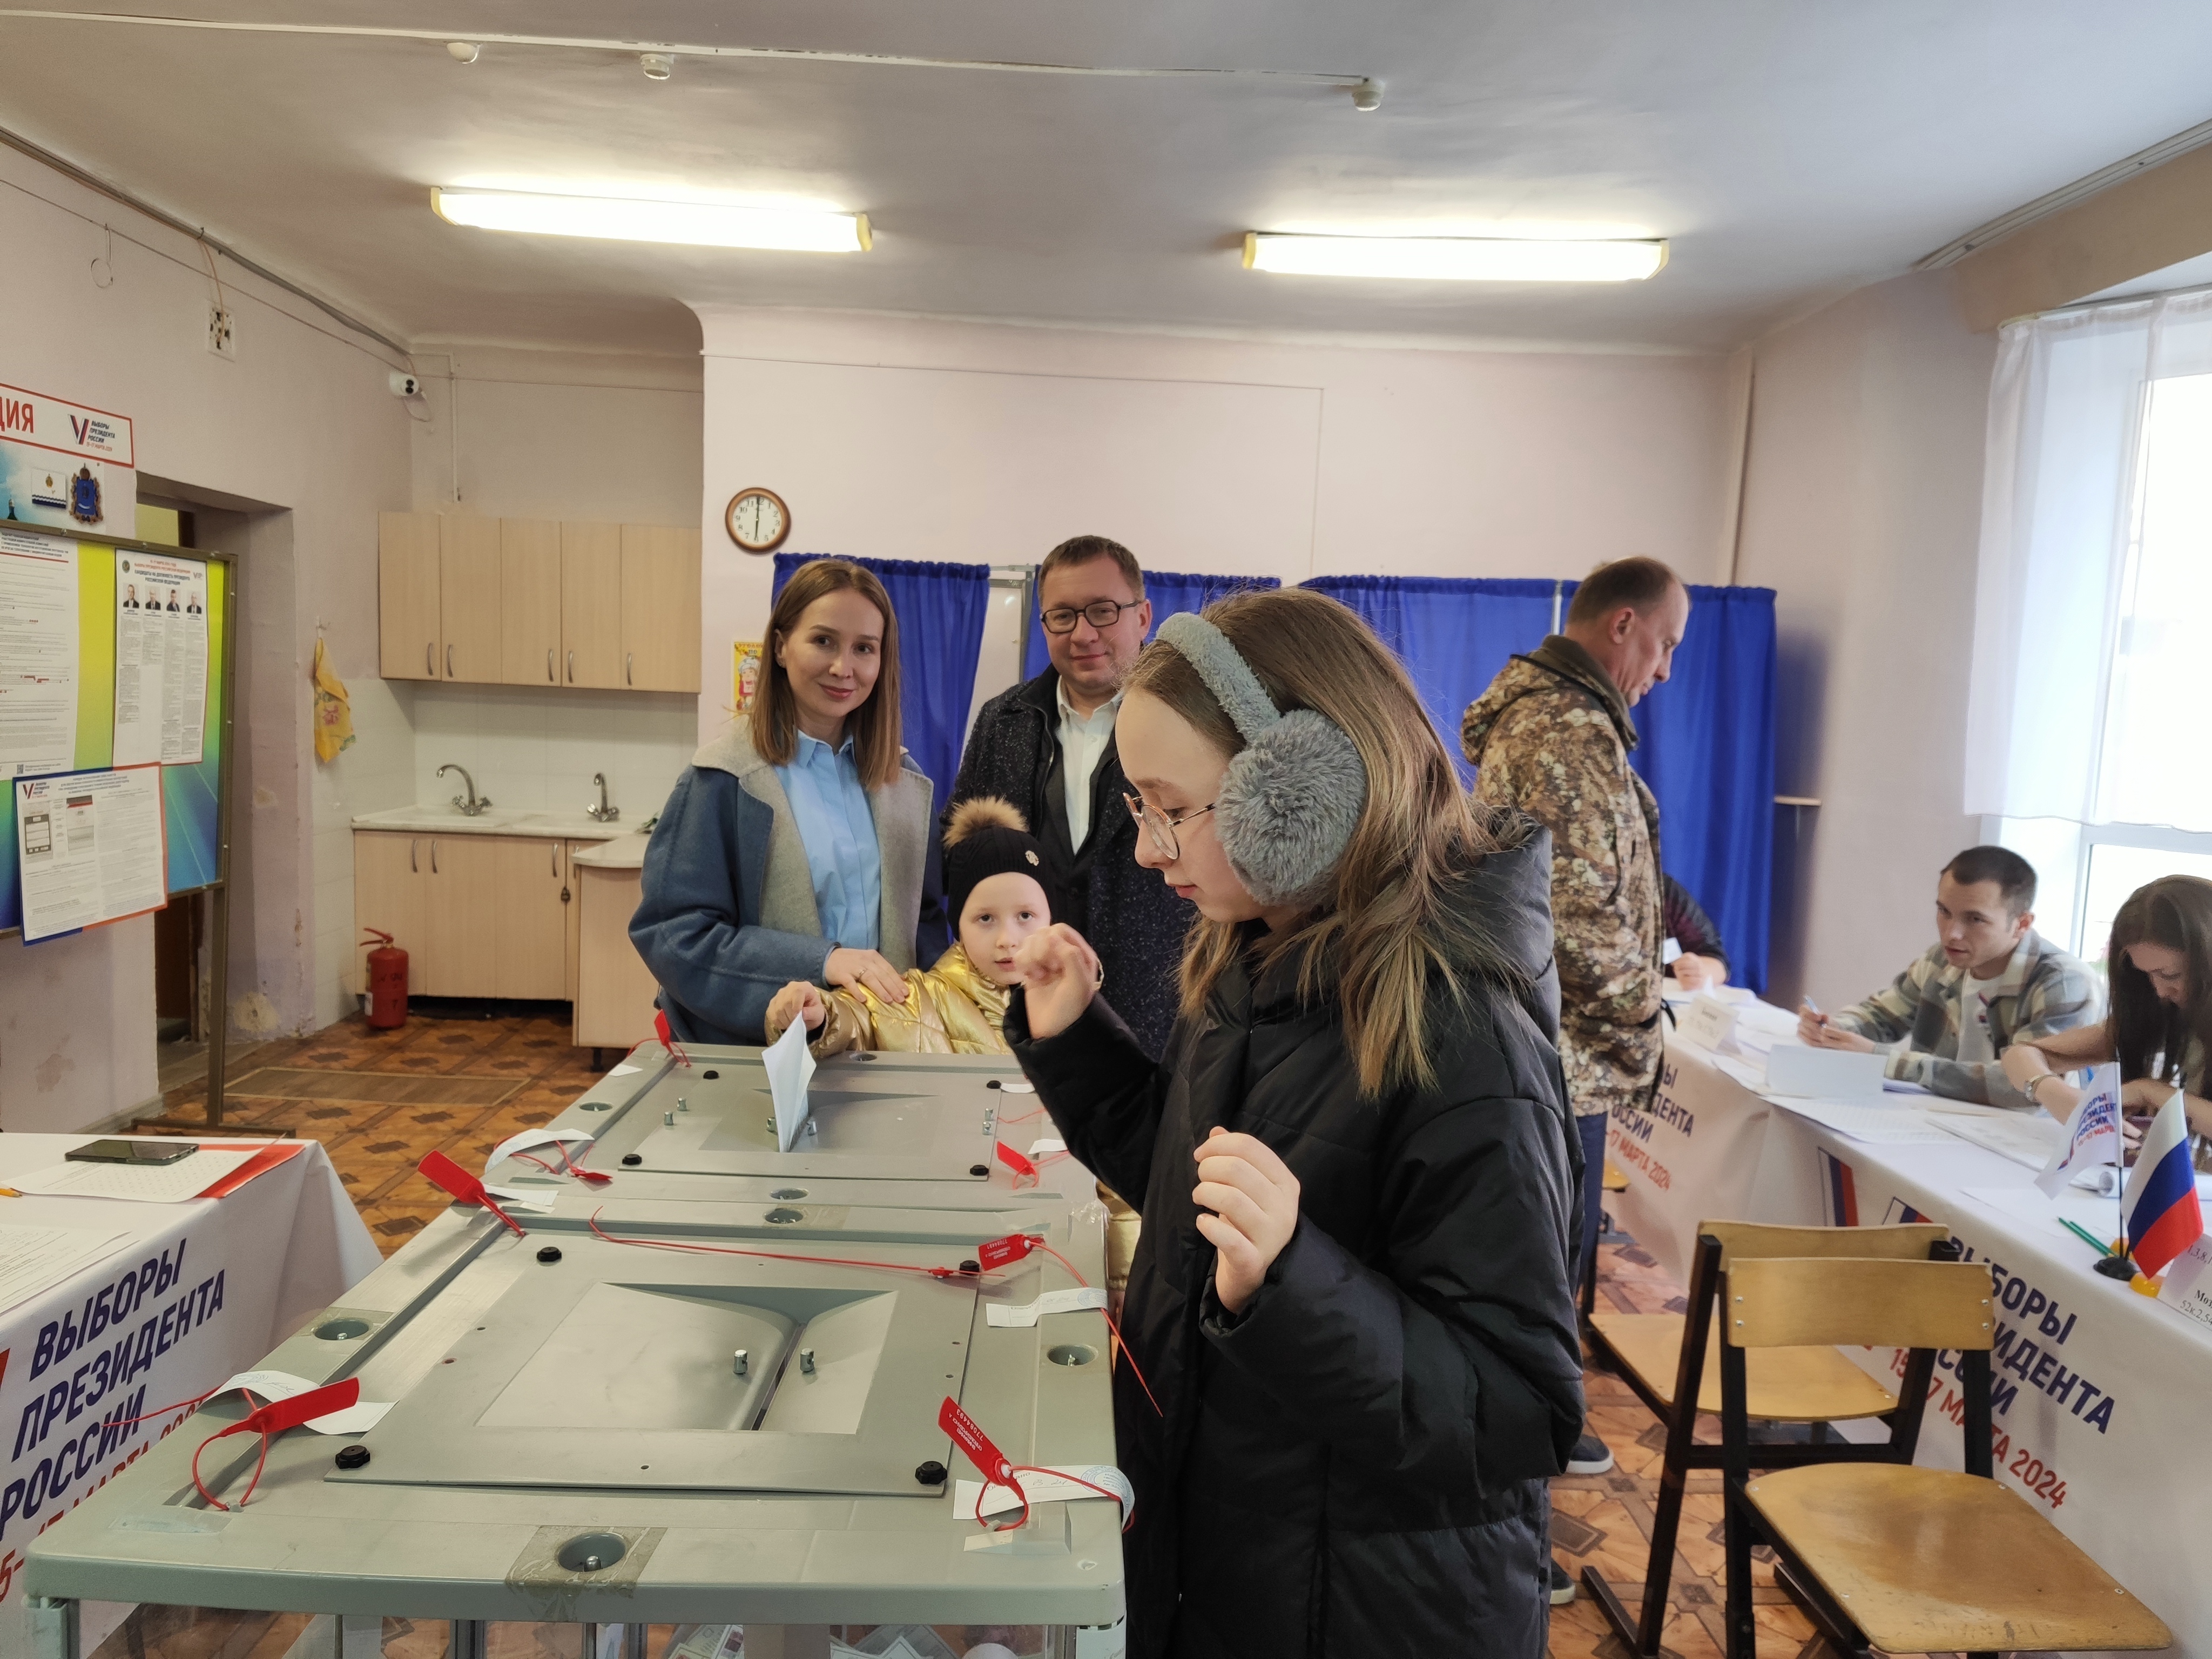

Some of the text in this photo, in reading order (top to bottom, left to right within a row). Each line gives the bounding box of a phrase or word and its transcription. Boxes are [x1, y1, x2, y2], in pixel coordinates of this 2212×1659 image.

[1611, 1105, 1654, 1143] ОССИИ
[1651, 1092, 1694, 1138] ДЕНТА
[11, 1269, 225, 1463] ПРЕЗИДЕНТА
[29, 1238, 186, 1382] ВЫБОРЫ
[1992, 1319, 2115, 1434] ИДЕНТА
[0, 1384, 146, 1542] РОССИИ
[2008, 1448, 2068, 1509] 2024
